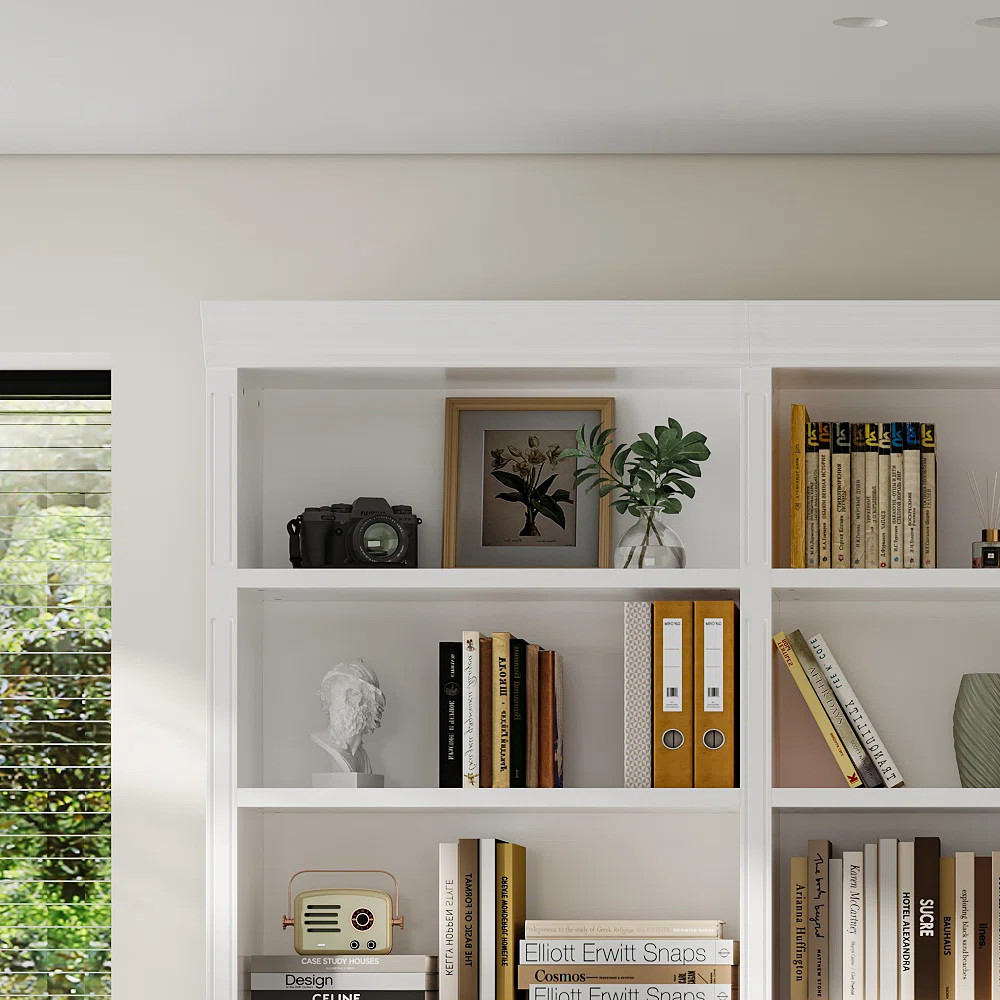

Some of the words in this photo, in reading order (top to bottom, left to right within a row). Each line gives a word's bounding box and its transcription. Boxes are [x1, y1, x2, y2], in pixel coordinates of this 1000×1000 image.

[850, 864, 861, 889] Karen
[795, 884, 806, 923] Arianna
[848, 891, 861, 935] McCartney
[902, 892, 911, 919] HOTEL
[919, 898, 934, 937] SUCRE
[960, 889, 969, 920] exploring
[525, 942, 576, 962] Elliott
[583, 942, 637, 962] Erwitt
[643, 942, 707, 965] Snaps
[902, 921, 911, 972] ALEXANDRA
[943, 916, 952, 956] BAUHAUS
[793, 927, 806, 982] Huffington
[285, 974, 333, 989] Design
[534, 969, 586, 983] Cosmos
